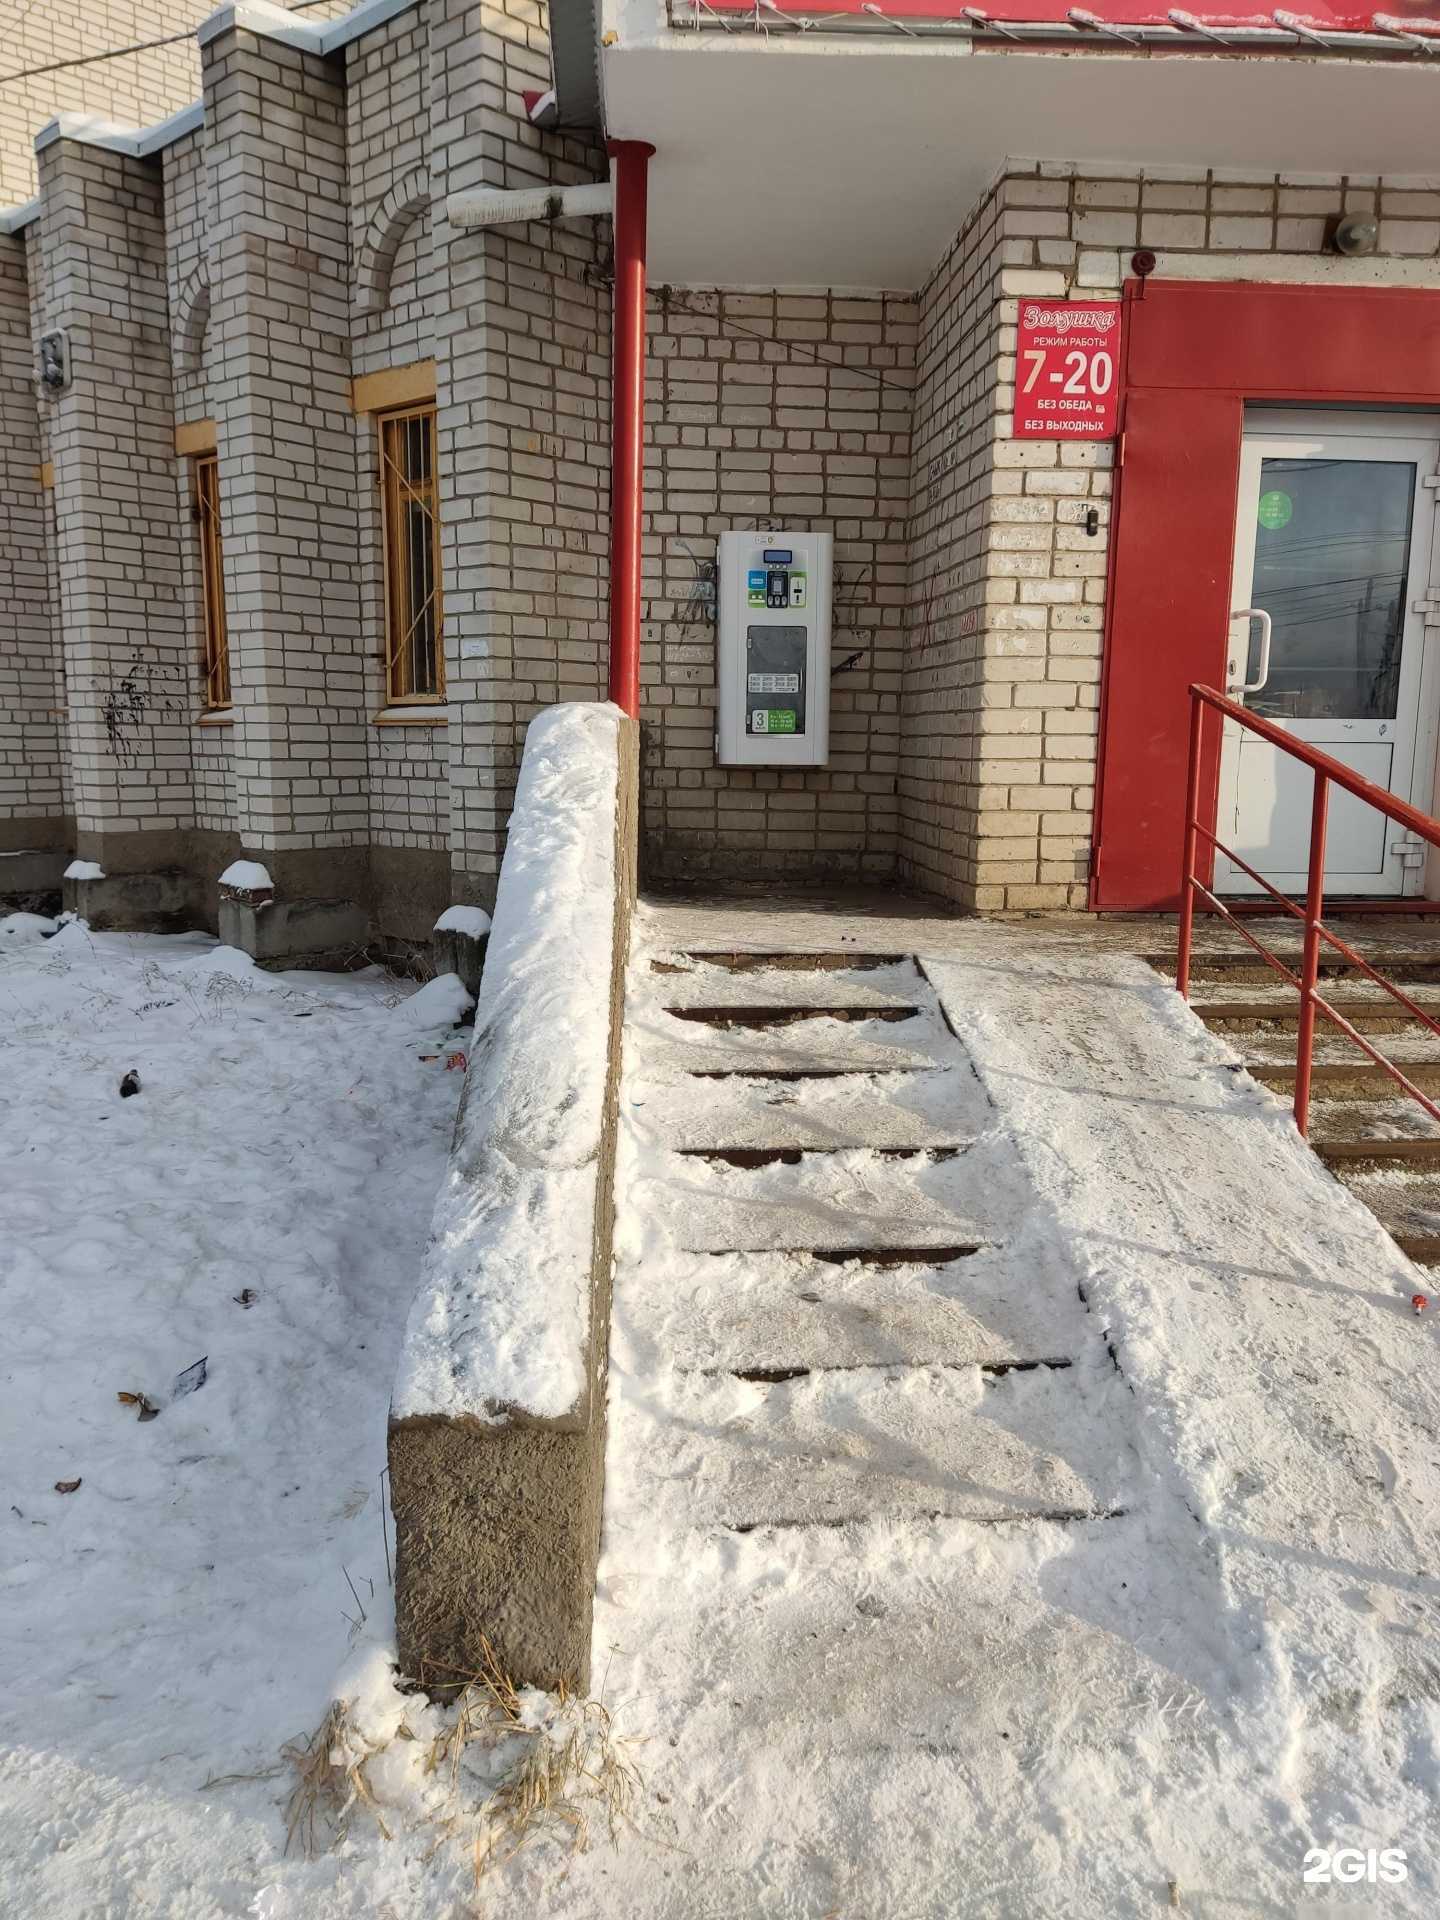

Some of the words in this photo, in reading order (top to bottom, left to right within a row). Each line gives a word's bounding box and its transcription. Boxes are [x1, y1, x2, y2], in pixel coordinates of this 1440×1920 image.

[1023, 305, 1116, 333] Золушка
[1033, 337, 1068, 346] РЕЖИМ
[1070, 337, 1107, 347] РАБОТЫ
[1022, 350, 1112, 395] 7-20
[1037, 400, 1057, 409] БЕЗ
[1059, 400, 1092, 410] ОБЕДА
[1025, 420, 1043, 429] БЕЗ
[1046, 421, 1104, 431] ВЫХОДНЫХ
[756, 713, 764, 726] 3
